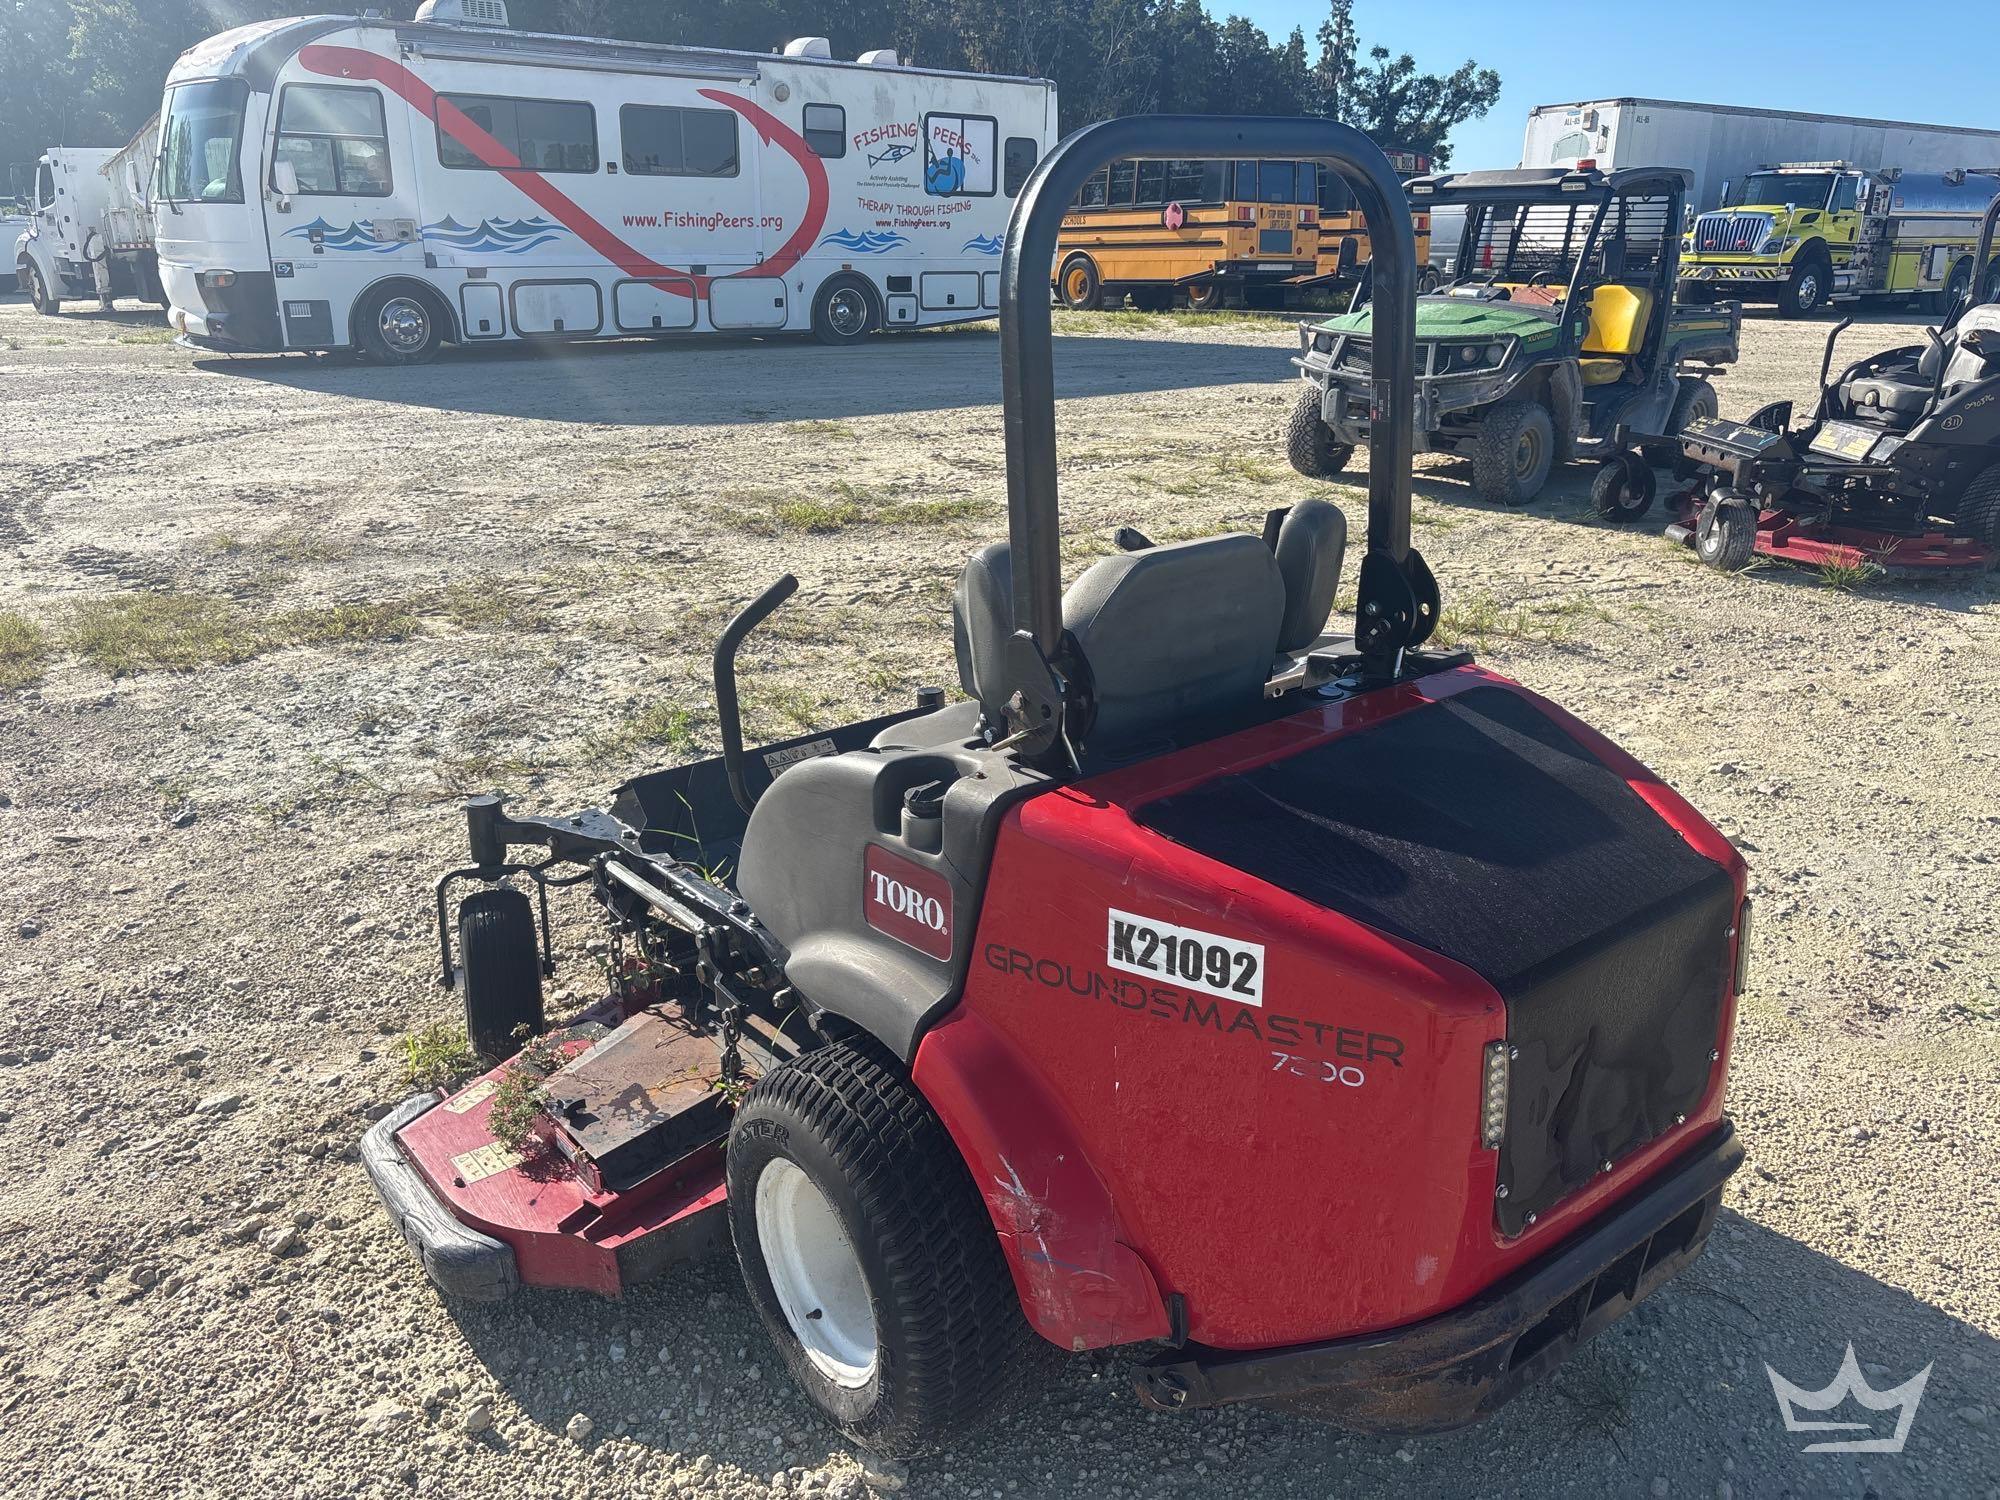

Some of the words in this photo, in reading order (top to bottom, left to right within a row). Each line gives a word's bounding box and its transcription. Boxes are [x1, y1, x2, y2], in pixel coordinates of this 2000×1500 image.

[853, 122, 917, 151] FISHING
[933, 126, 972, 156] PEERS
[1401, 156, 1414, 169] BUS
[858, 197, 893, 214] THERAPY
[897, 204, 935, 217] THROUGH
[937, 200, 972, 216] FISHING
[622, 211, 783, 232] www.FishingPeers.org
[875, 218, 951, 229] www.FishingPeers.org
[870, 869, 945, 931] TORO
[1113, 920, 1258, 997] K21092
[985, 943, 1405, 1068] GROUNDSMASTER
